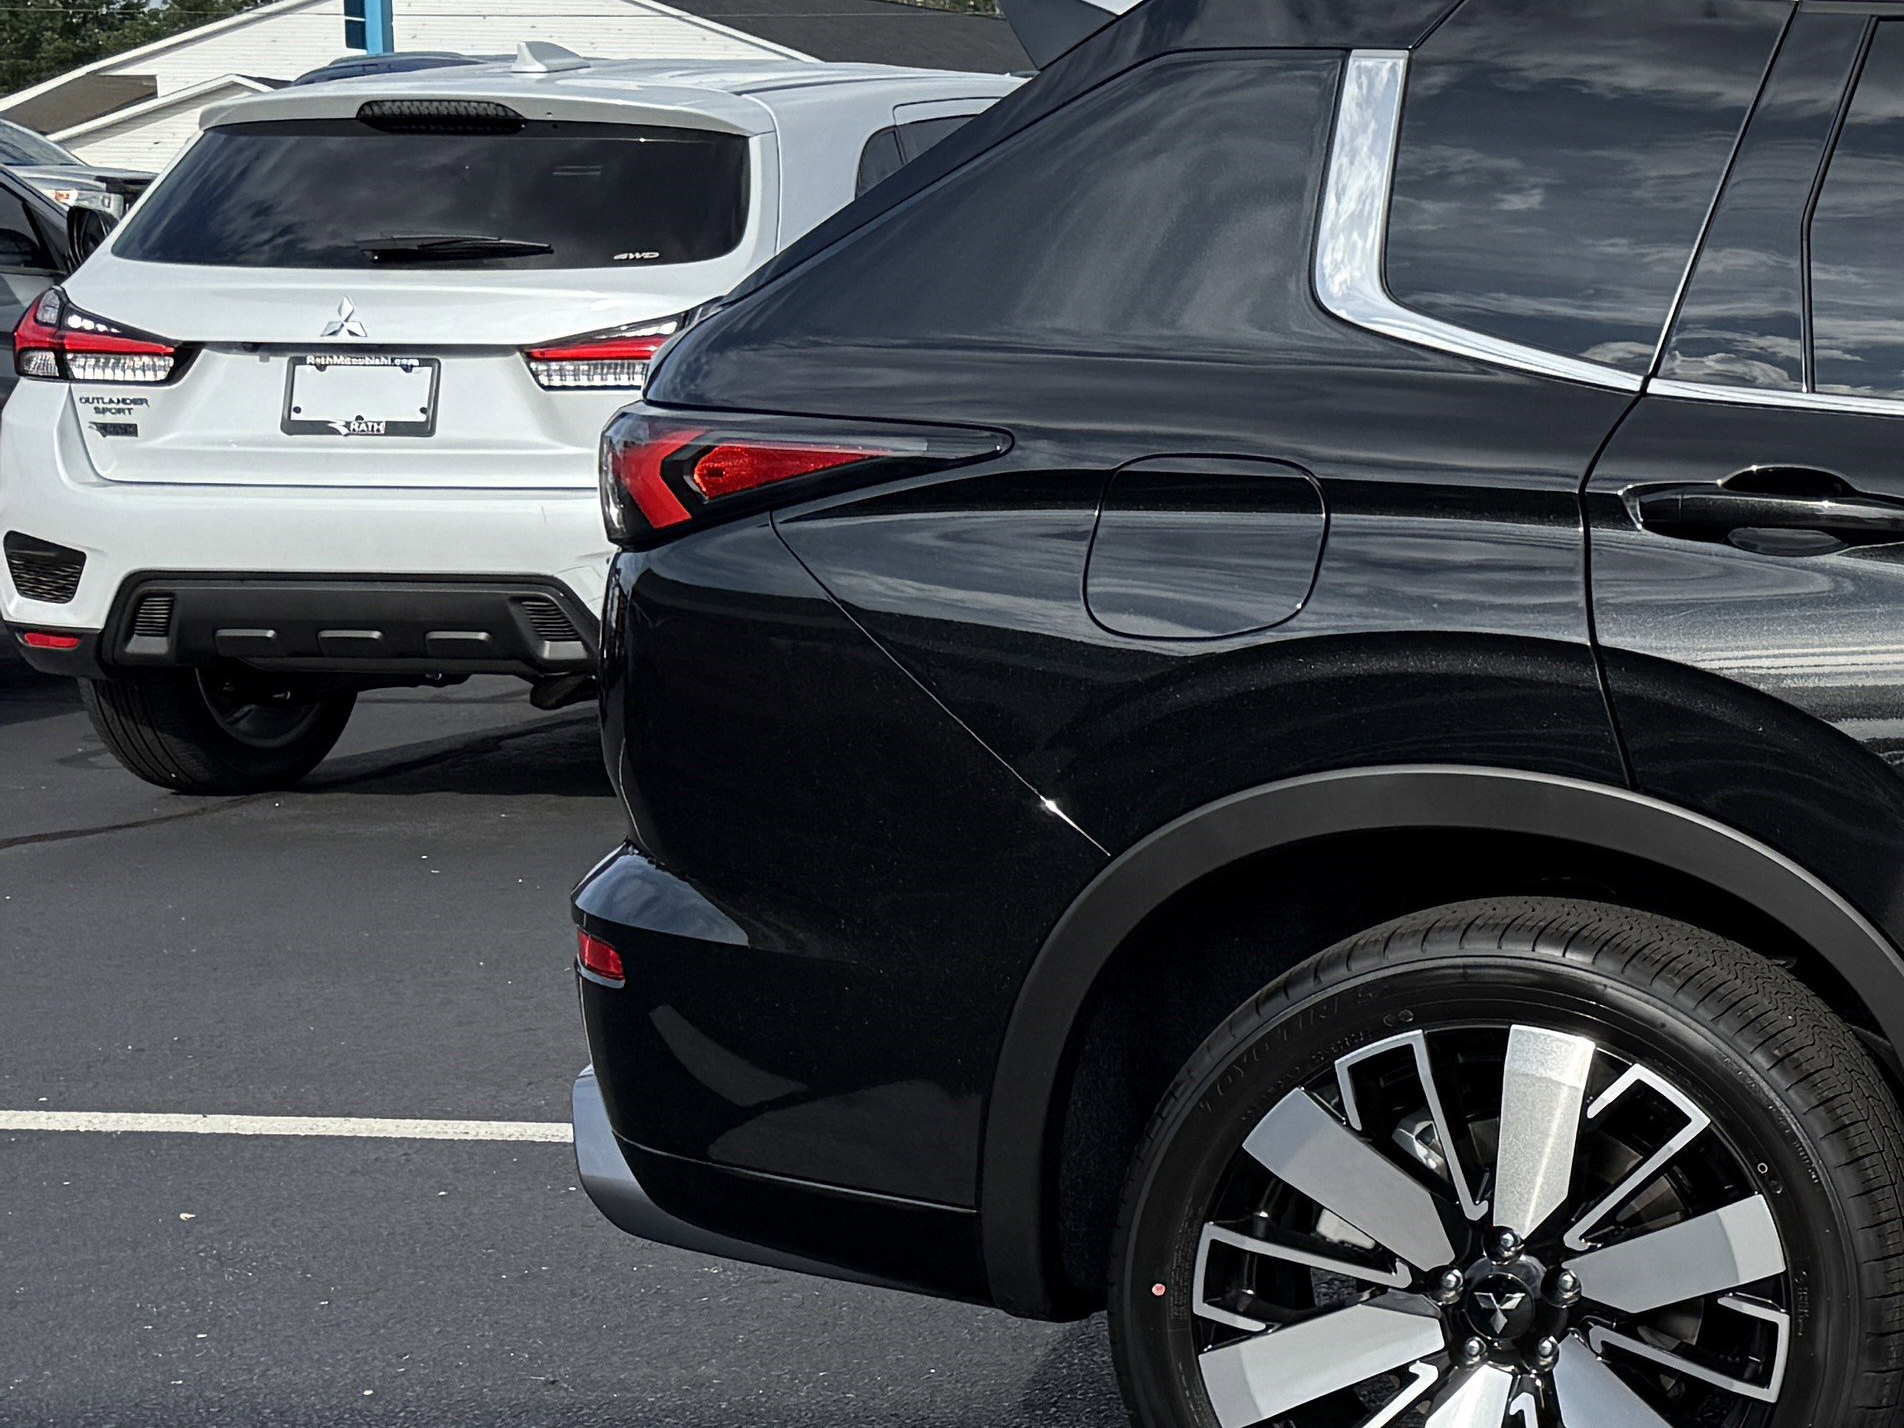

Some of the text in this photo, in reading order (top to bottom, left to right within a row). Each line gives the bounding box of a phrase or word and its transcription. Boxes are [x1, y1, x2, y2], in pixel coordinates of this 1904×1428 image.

[79, 396, 150, 408] OUTLANDER
[93, 406, 133, 415] SPORT
[349, 422, 385, 434] RATH
